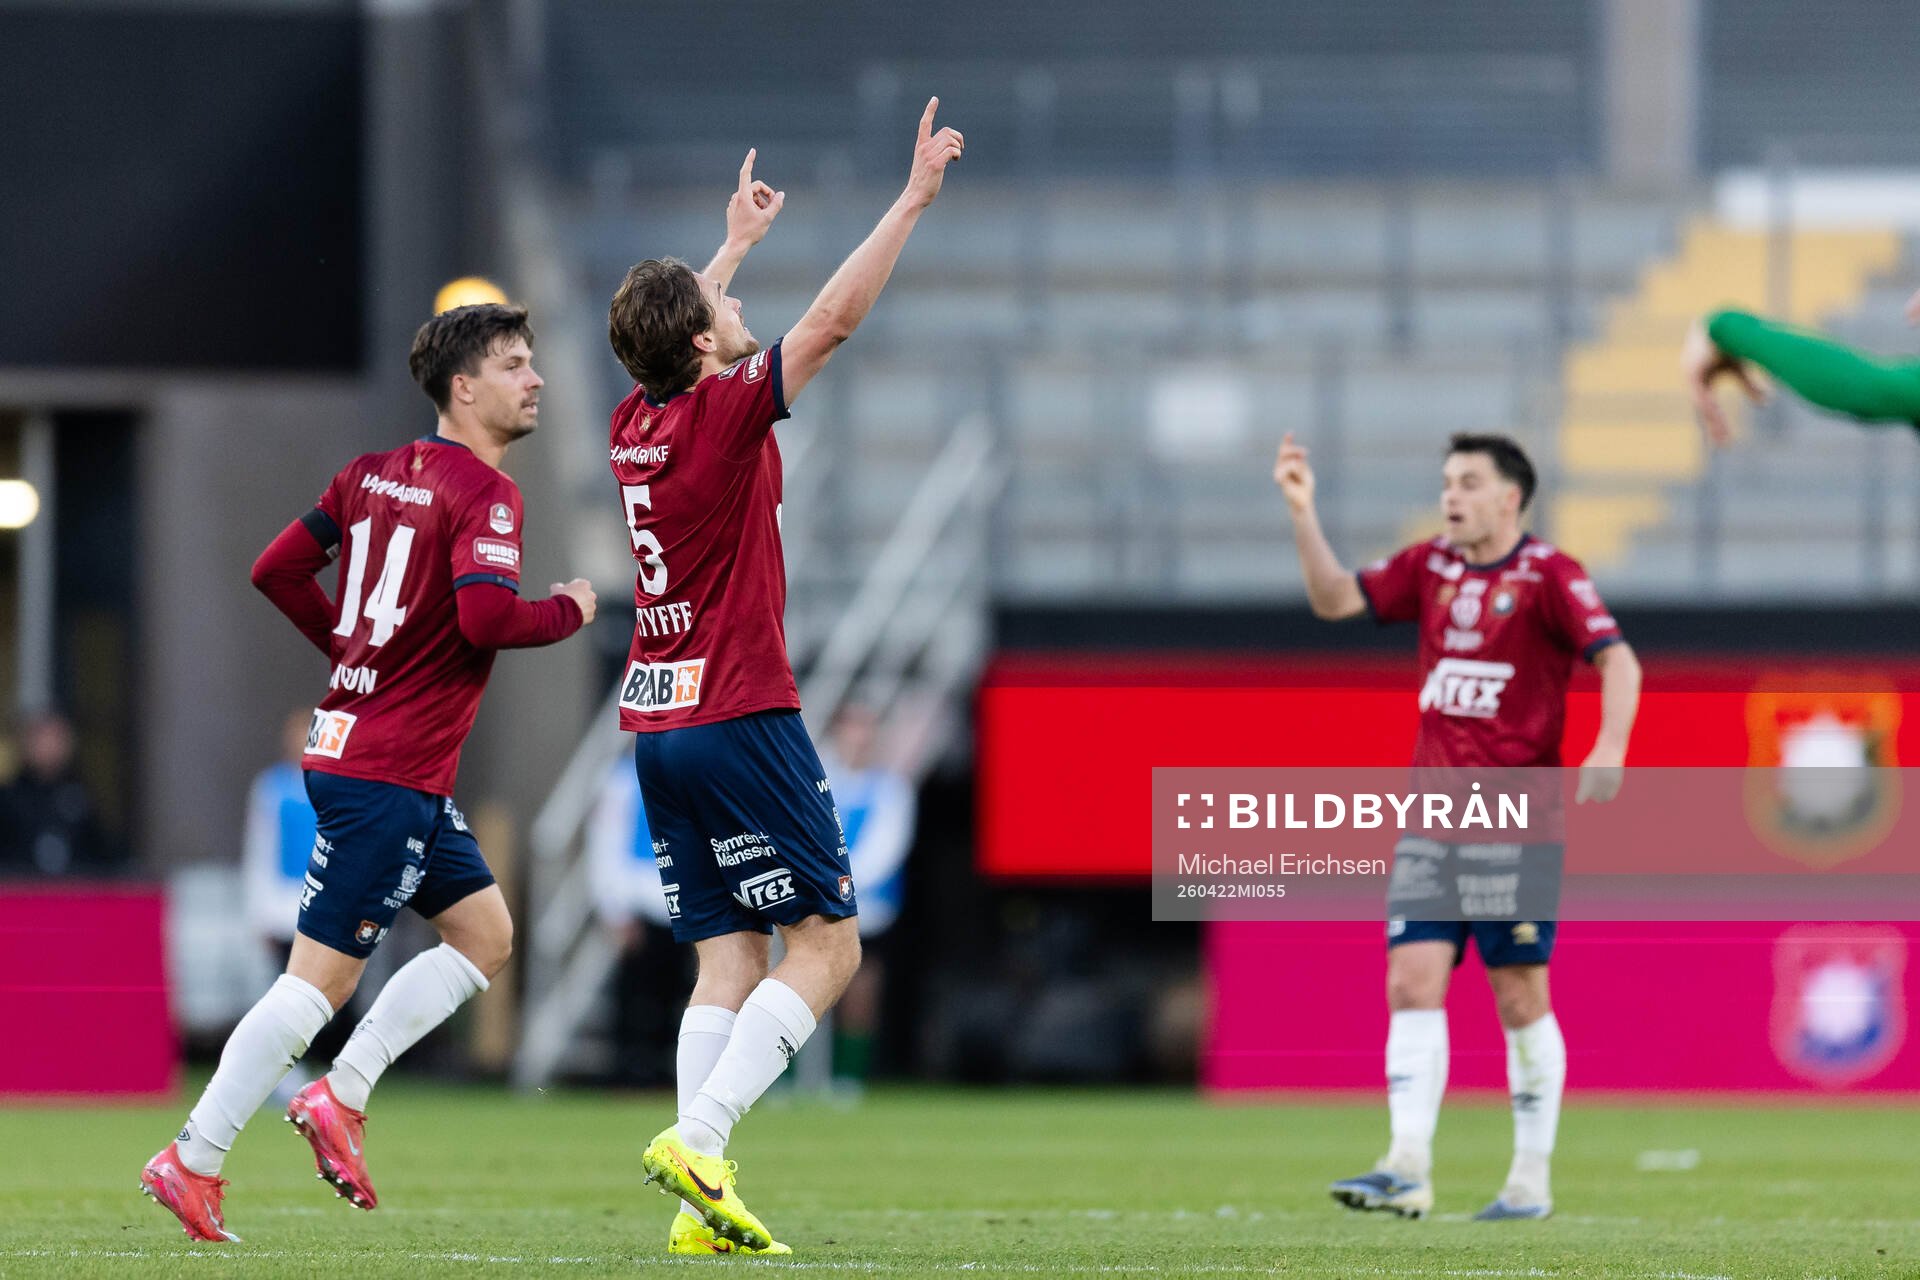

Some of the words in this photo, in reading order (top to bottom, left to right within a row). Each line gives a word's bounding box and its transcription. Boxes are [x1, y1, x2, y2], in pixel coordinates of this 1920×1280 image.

[622, 484, 669, 596] 5
[477, 543, 520, 562] UNIBET
[332, 516, 417, 647] 14
[710, 831, 770, 853] Semrén+
[715, 844, 777, 868] Månsson
